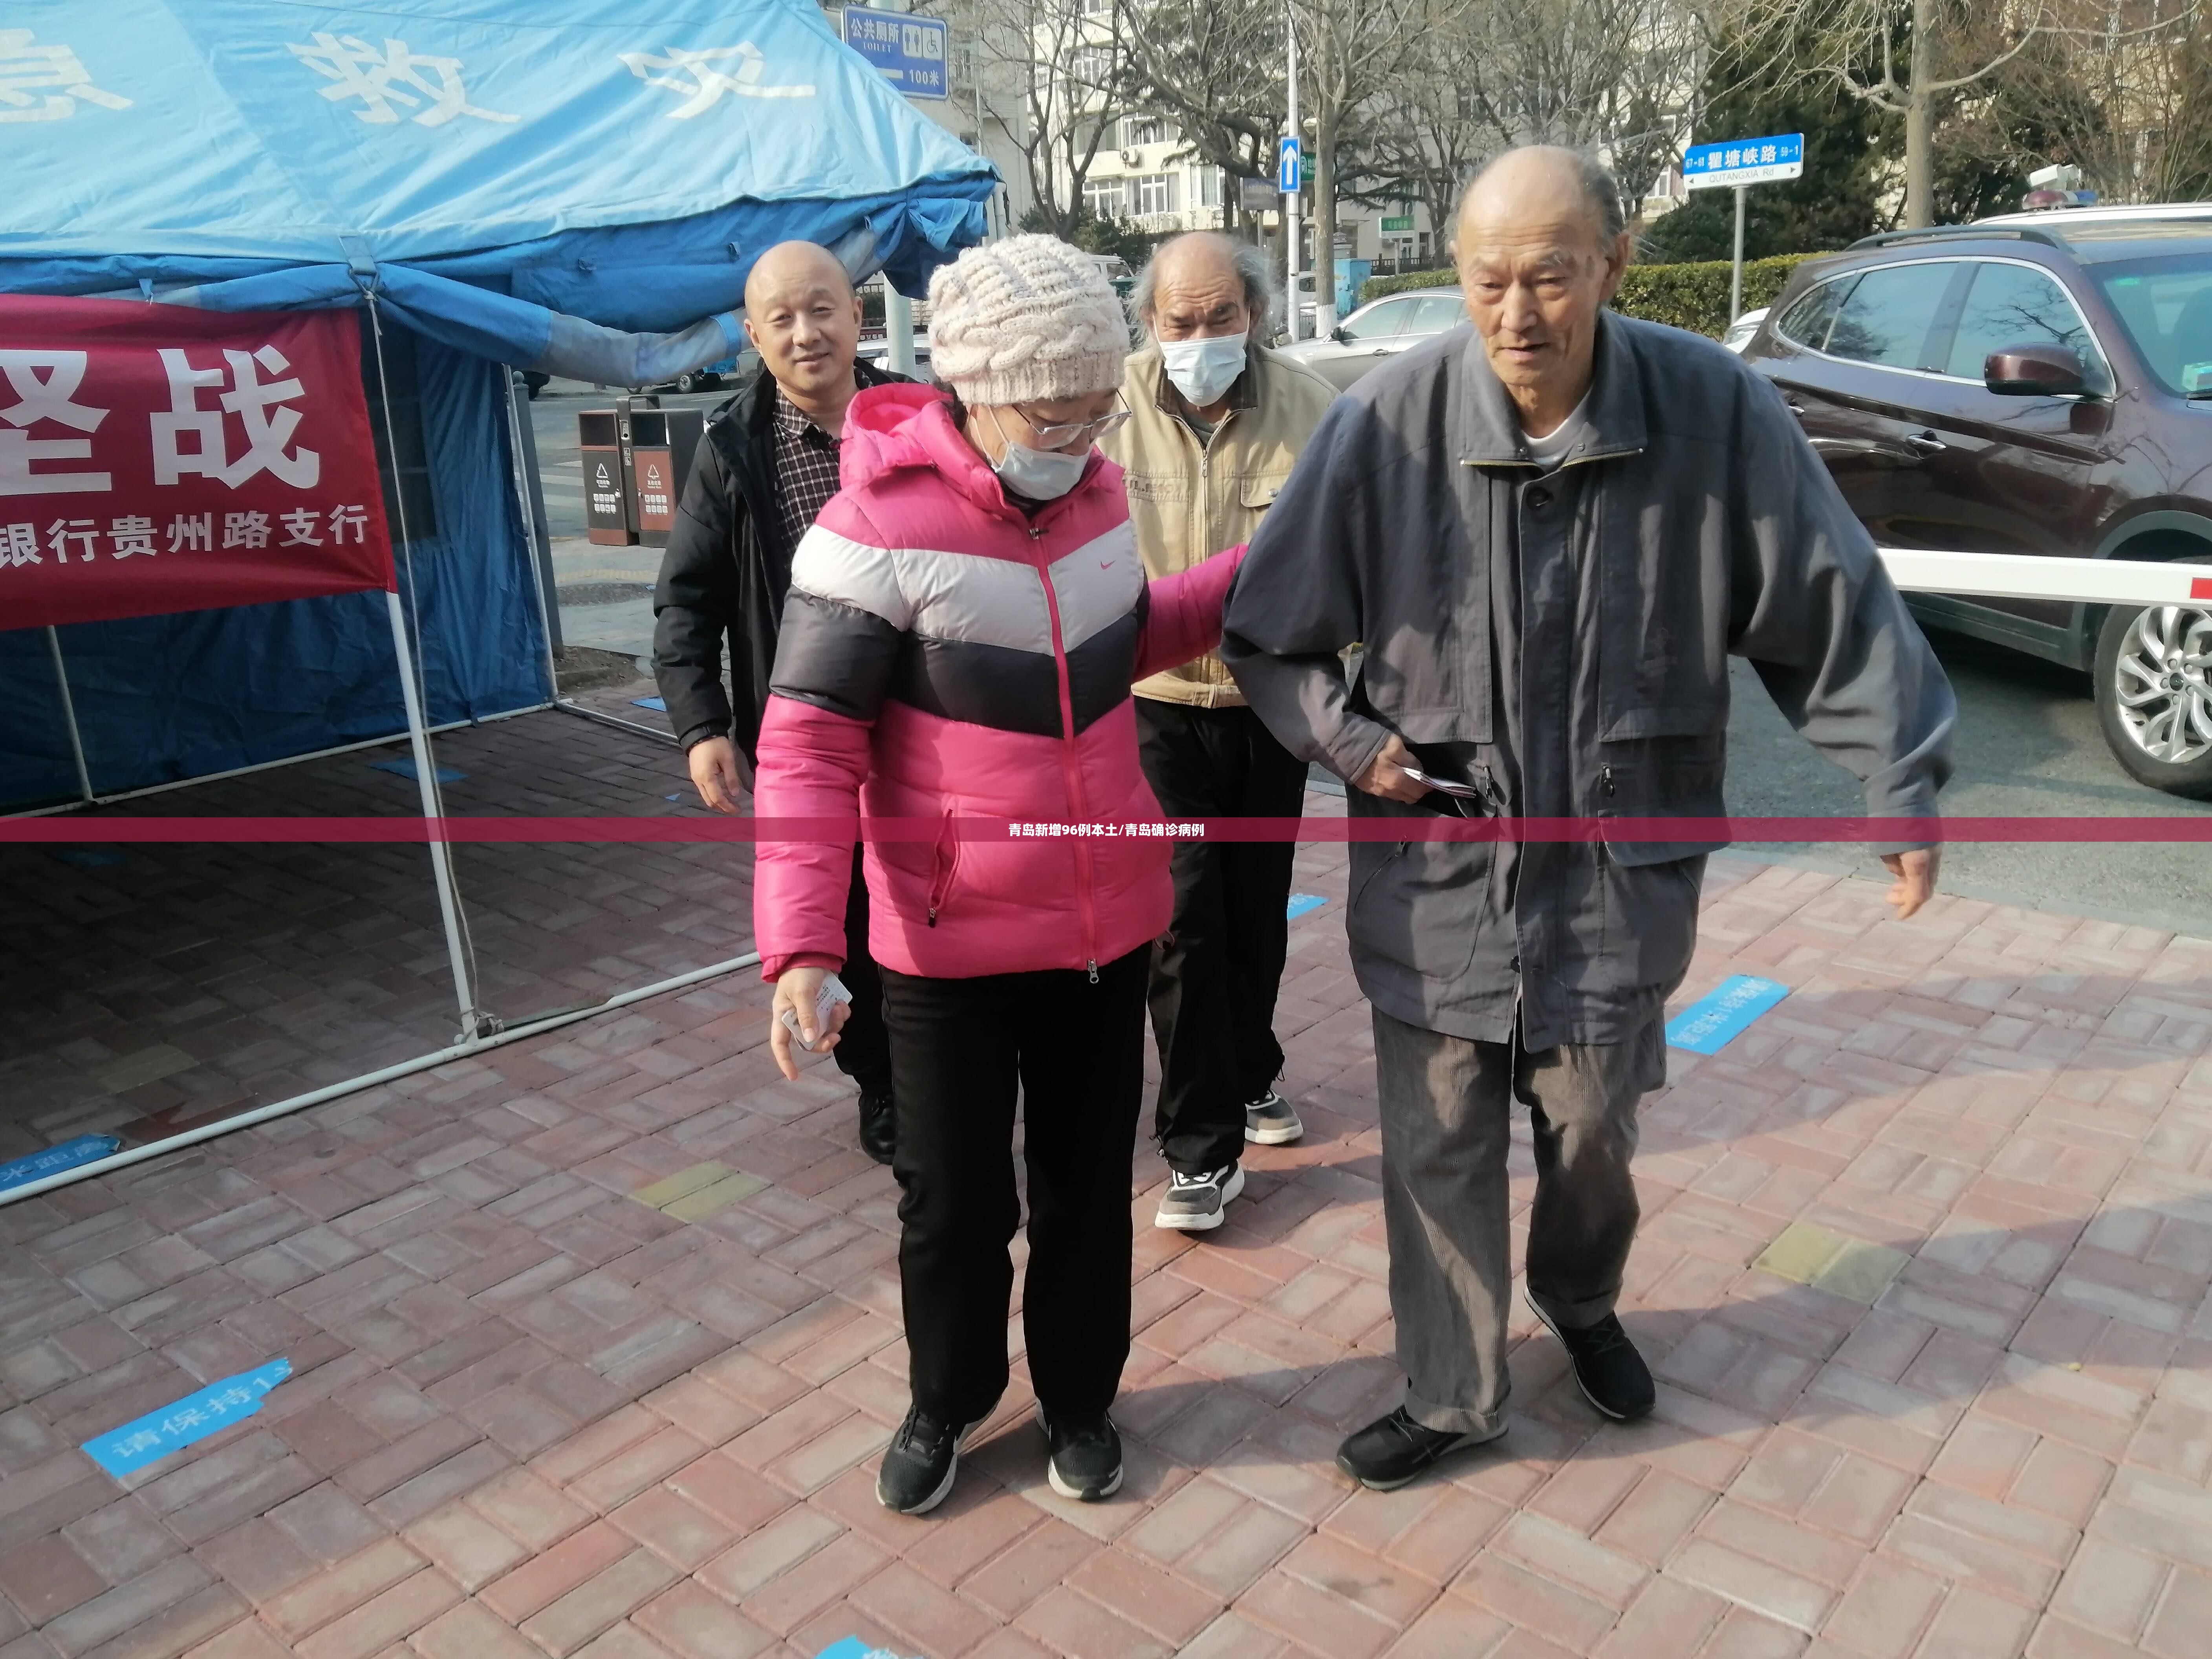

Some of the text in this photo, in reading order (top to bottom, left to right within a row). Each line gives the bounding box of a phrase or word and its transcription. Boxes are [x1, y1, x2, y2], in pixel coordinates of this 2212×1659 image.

[851, 17, 899, 44] 公共厕所
[863, 42, 892, 53] TOILET
[909, 69, 939, 86] 100米
[1708, 144, 1776, 169] 瞿塘峡路
[1710, 168, 1774, 183] QUTANGXIA Rd
